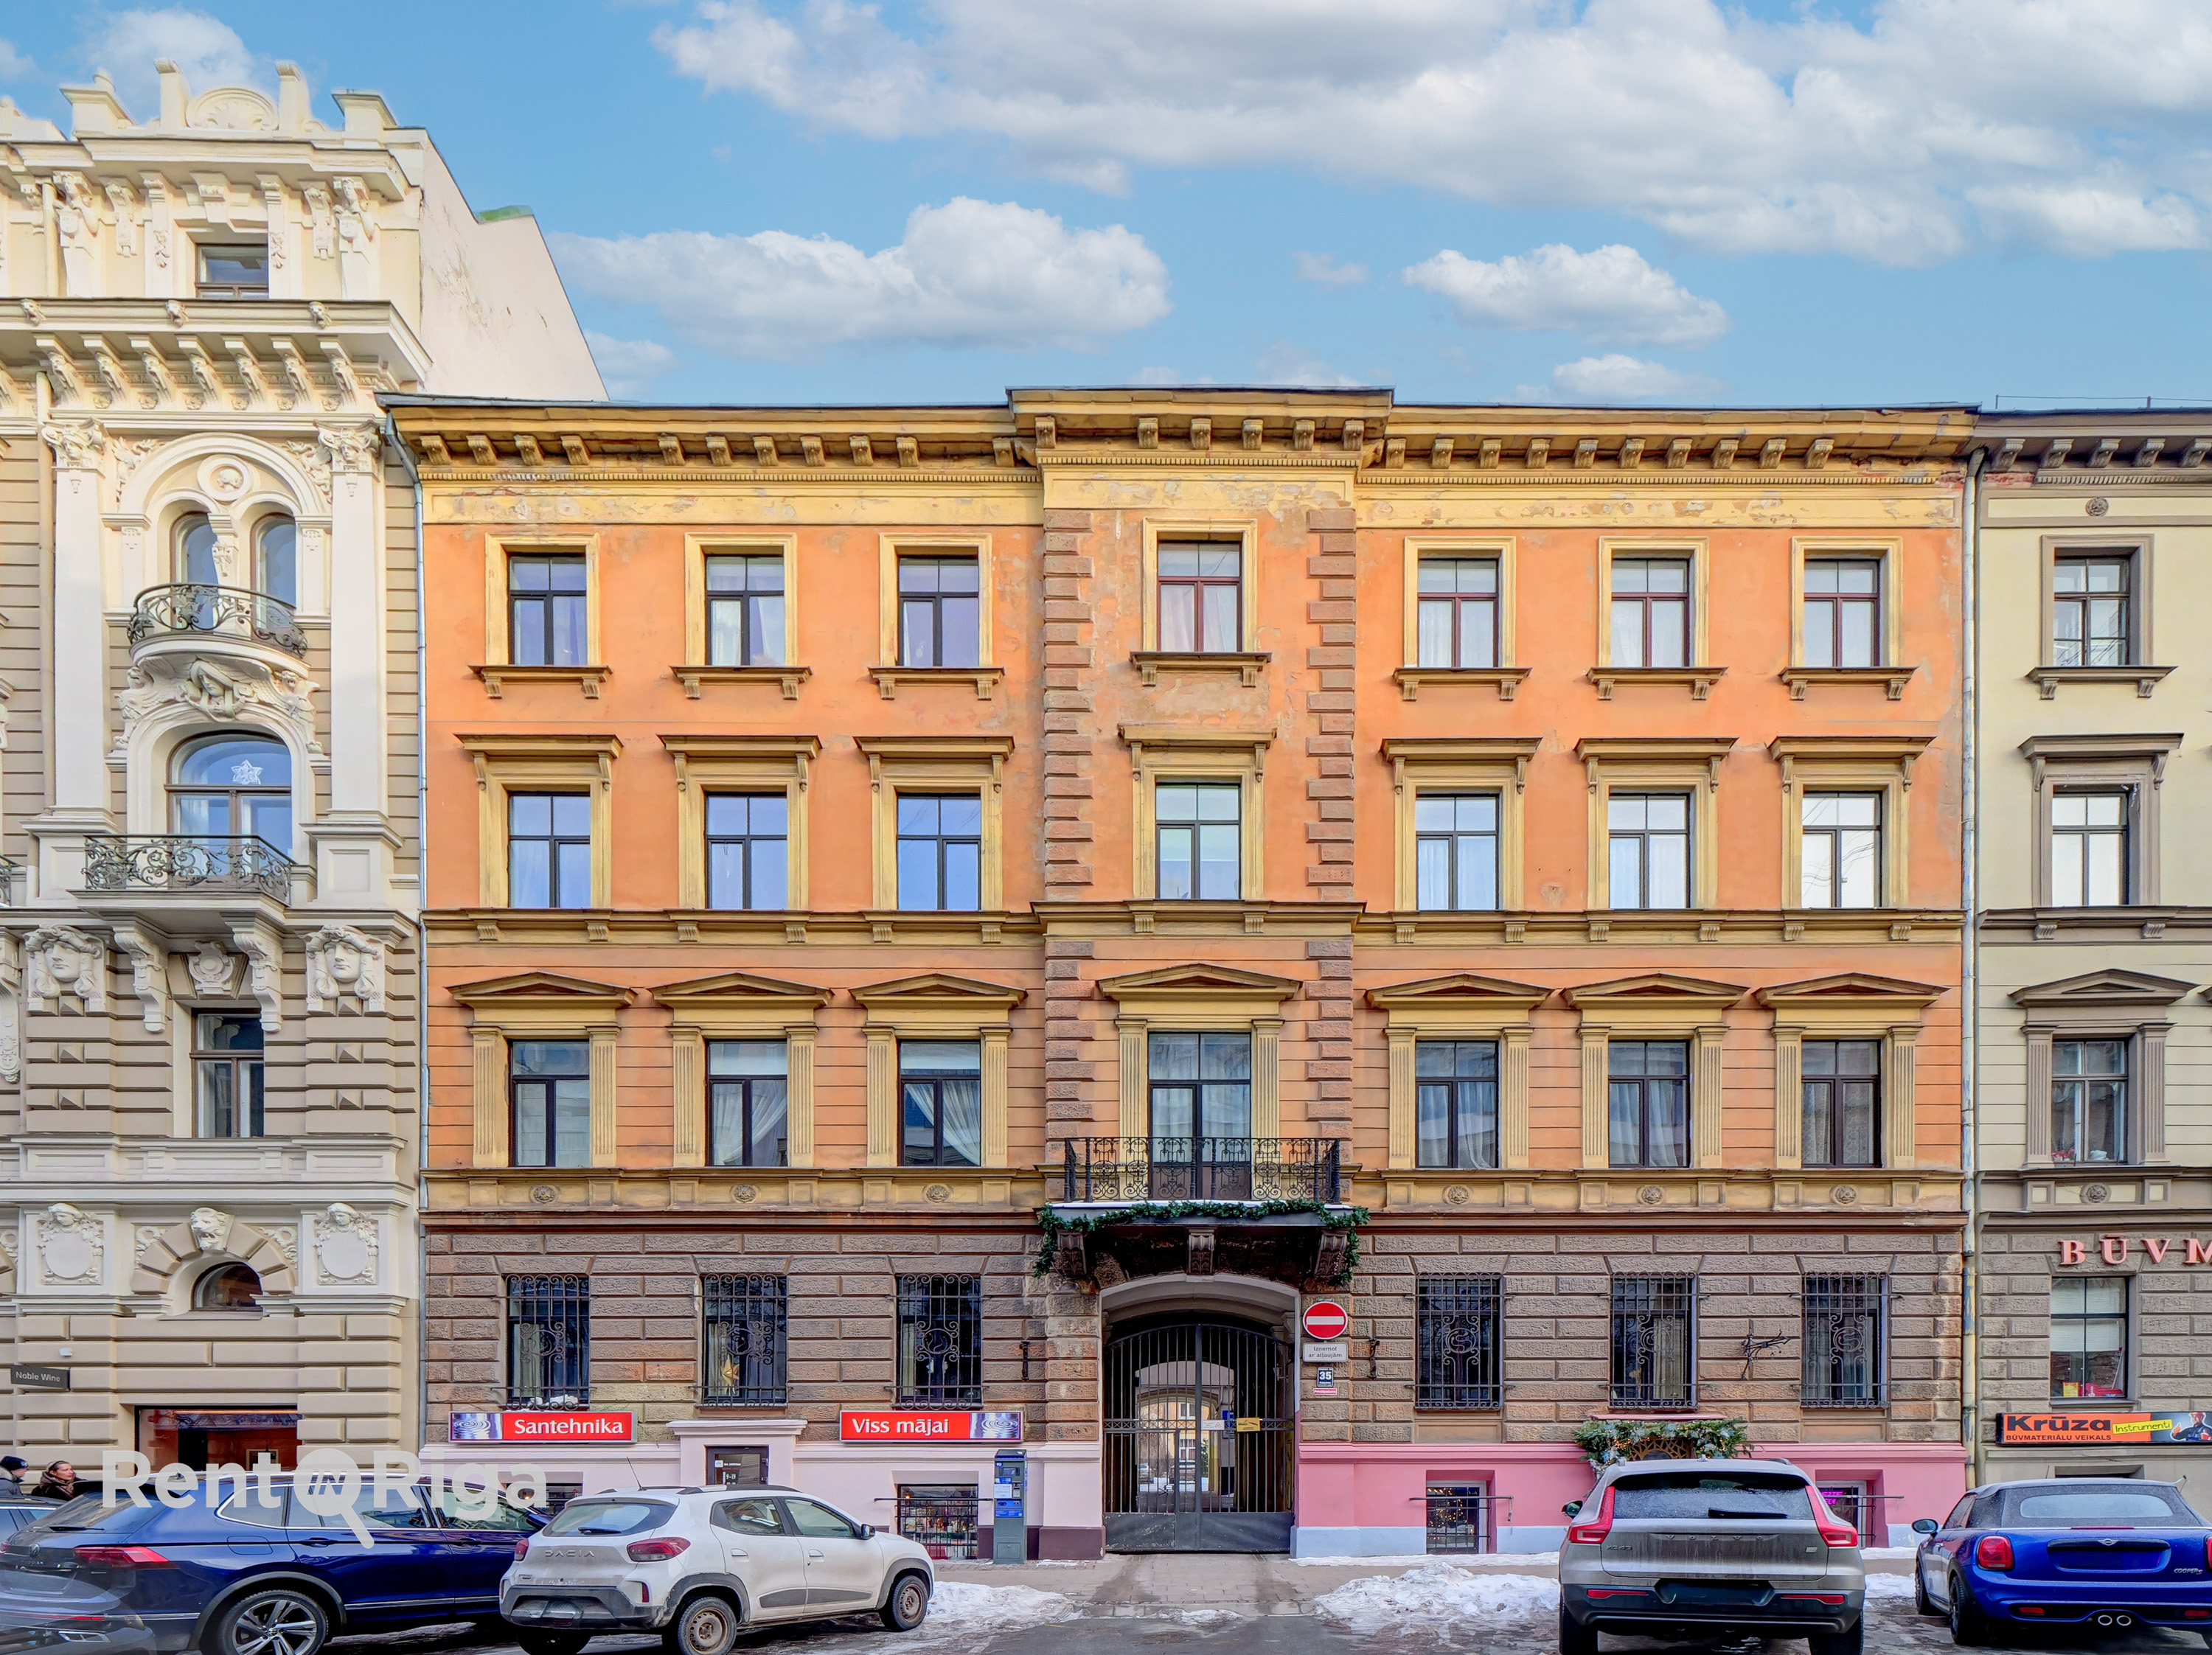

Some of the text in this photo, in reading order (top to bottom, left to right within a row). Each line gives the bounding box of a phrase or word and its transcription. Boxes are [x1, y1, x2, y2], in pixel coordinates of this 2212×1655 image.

[15, 1371, 60, 1382] Noble Wine
[1319, 1371, 1332, 1380] 35
[515, 1418, 624, 1435] Santehnika
[852, 1418, 949, 1436] Viss mājai
[2006, 1415, 2111, 1432] Krūza
[2115, 1421, 2170, 1432] Instrumenti
[544, 1550, 595, 1558] DACIA
